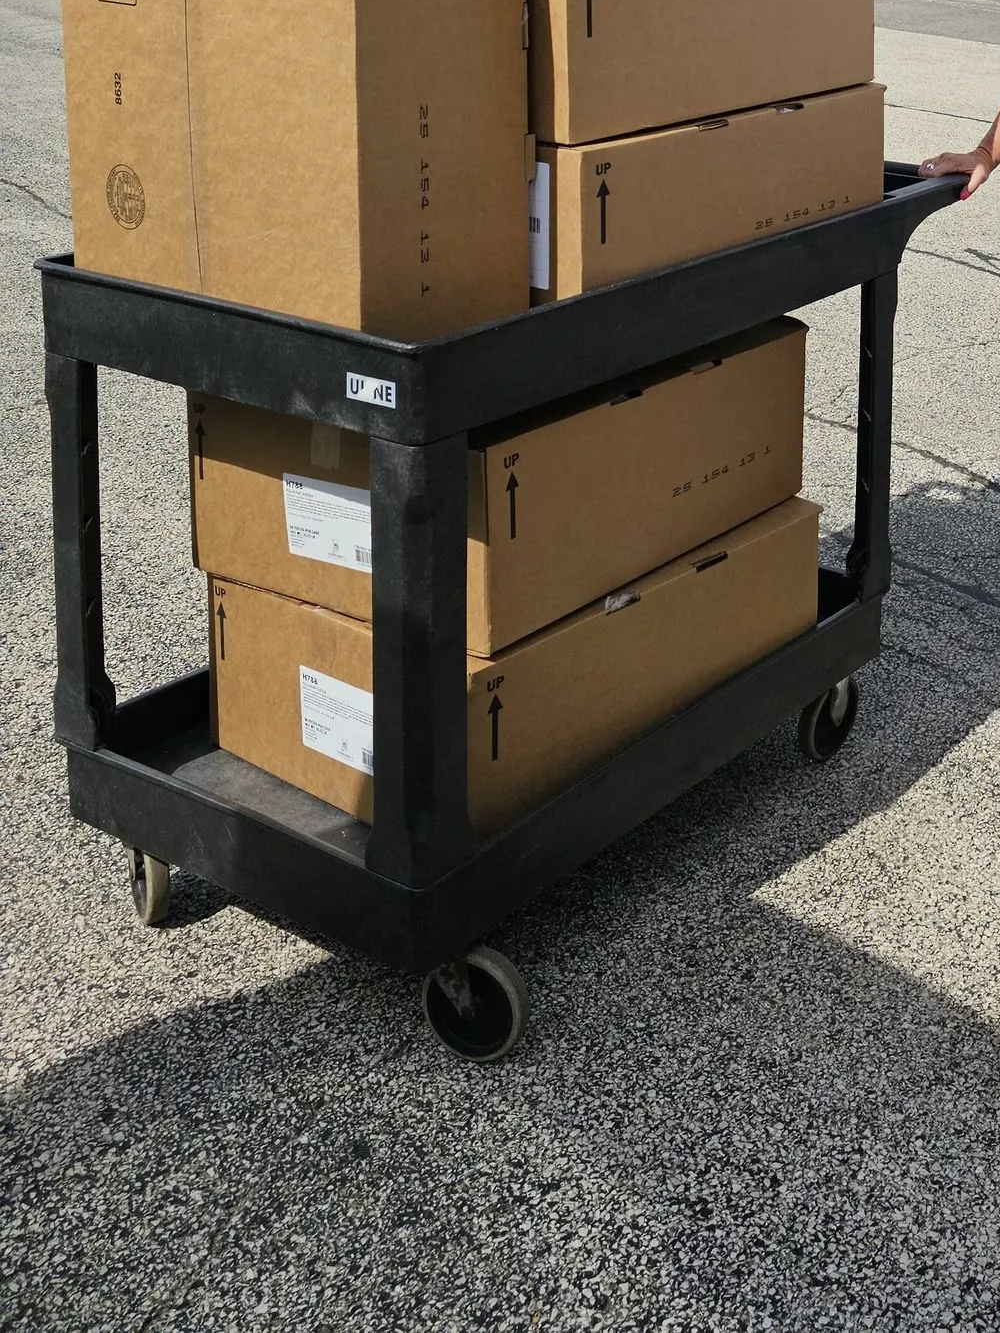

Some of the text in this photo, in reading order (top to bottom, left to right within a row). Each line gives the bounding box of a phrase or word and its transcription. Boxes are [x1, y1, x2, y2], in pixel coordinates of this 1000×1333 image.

[114, 72, 122, 106] 8632
[596, 162, 611, 175] UP
[419, 104, 431, 297] 25 154 13 1
[755, 195, 851, 230] 25 154 13 1
[350, 378, 392, 403] UNE
[193, 401, 206, 415] UP
[504, 453, 519, 469] UP
[672, 446, 771, 497] 25 154 13 1
[286, 479, 303, 490] H788
[214, 585, 226, 598] UP
[302, 673, 318, 685] H788
[487, 676, 504, 693] UP
